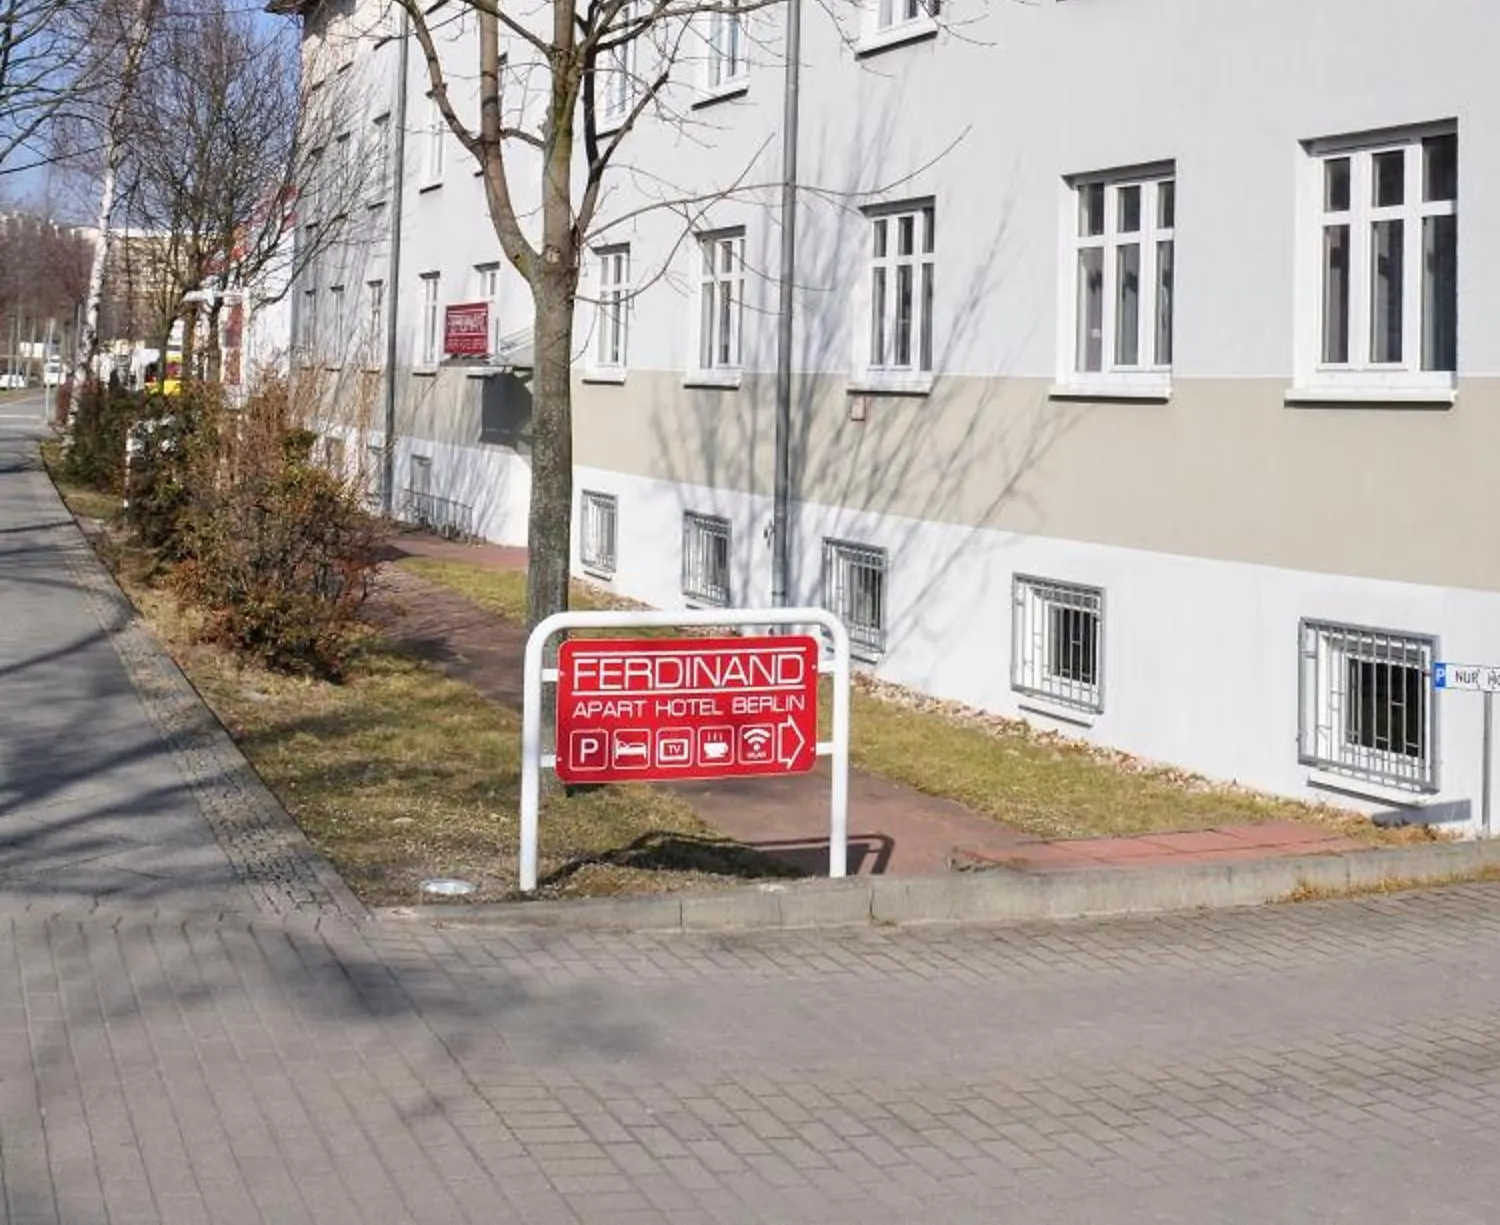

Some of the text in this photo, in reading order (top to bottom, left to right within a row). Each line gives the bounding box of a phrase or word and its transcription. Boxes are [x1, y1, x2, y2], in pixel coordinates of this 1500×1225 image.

[573, 654, 805, 689] FERDINAND
[1455, 670, 1479, 684] NUR
[572, 695, 805, 718] APART HOTEL BERLIN
[580, 738, 599, 763] P
[667, 744, 681, 754] TV
